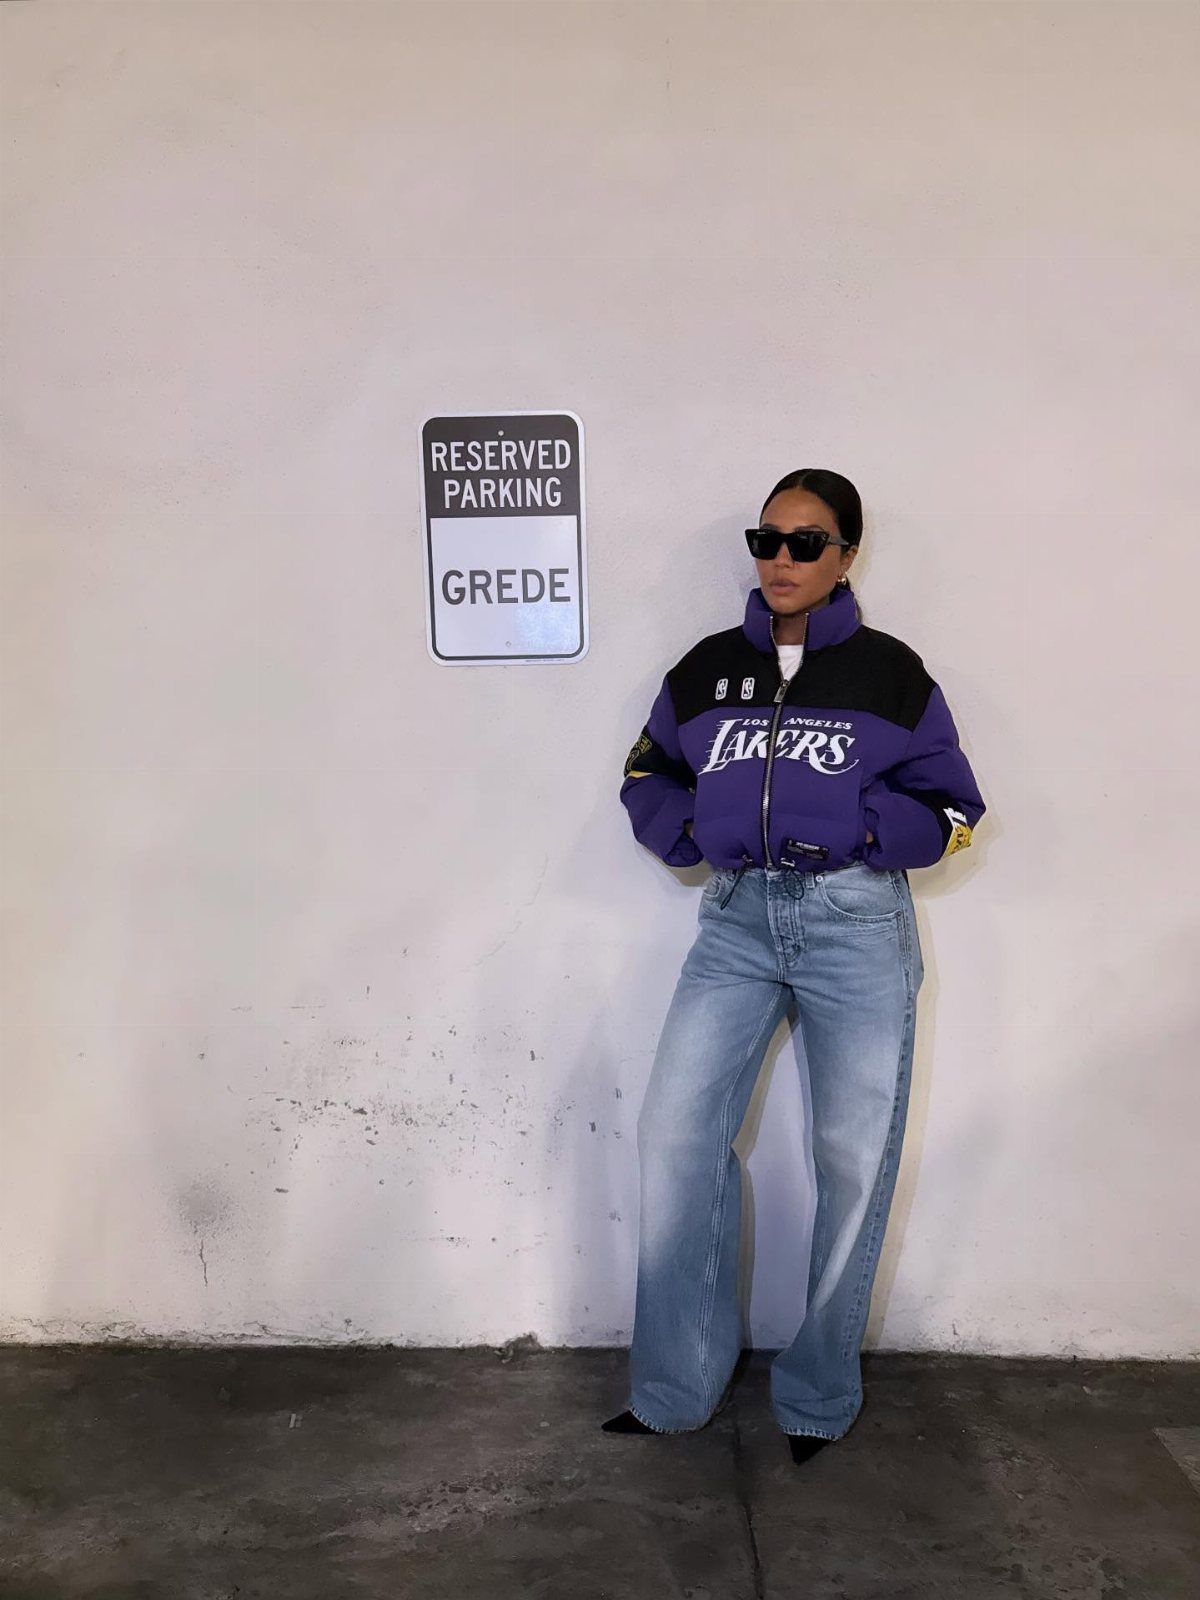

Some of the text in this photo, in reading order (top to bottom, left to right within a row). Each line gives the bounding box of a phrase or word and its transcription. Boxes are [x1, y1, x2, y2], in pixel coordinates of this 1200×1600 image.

[431, 439, 572, 472] RESERVED
[443, 477, 562, 509] PARKING
[442, 568, 571, 606] GREDE
[742, 717, 853, 730] LOS ANGELES
[697, 718, 860, 775] LAKERS
